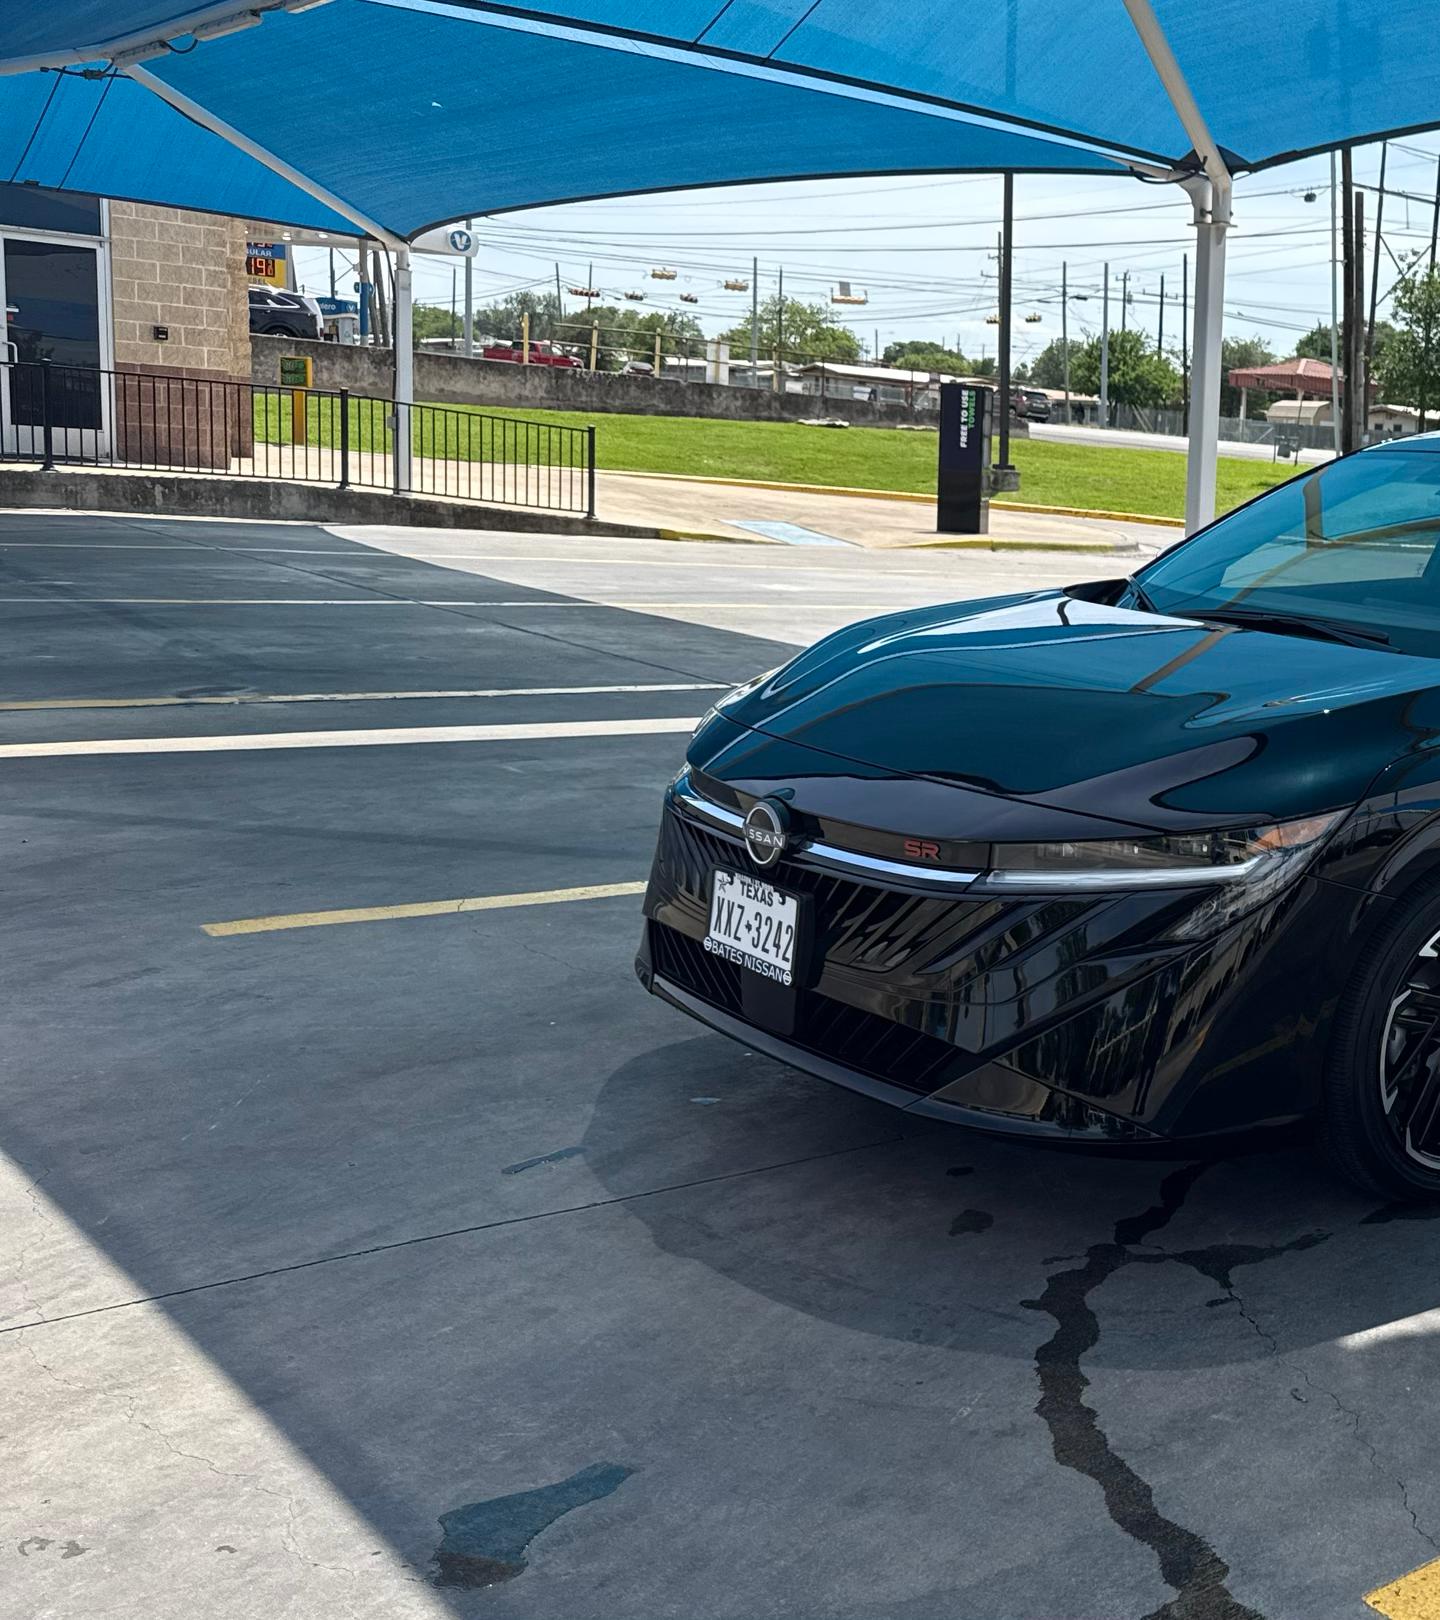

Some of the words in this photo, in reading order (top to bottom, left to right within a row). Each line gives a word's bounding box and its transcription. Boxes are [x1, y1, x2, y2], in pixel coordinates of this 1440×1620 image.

[246, 248, 272, 257] ULAR
[961, 410, 968, 423] TO
[960, 424, 968, 448] FREE
[903, 839, 940, 861] SR
[740, 880, 774, 907] TEXAS
[711, 941, 743, 965] BATES
[744, 954, 783, 982] NISSAN
